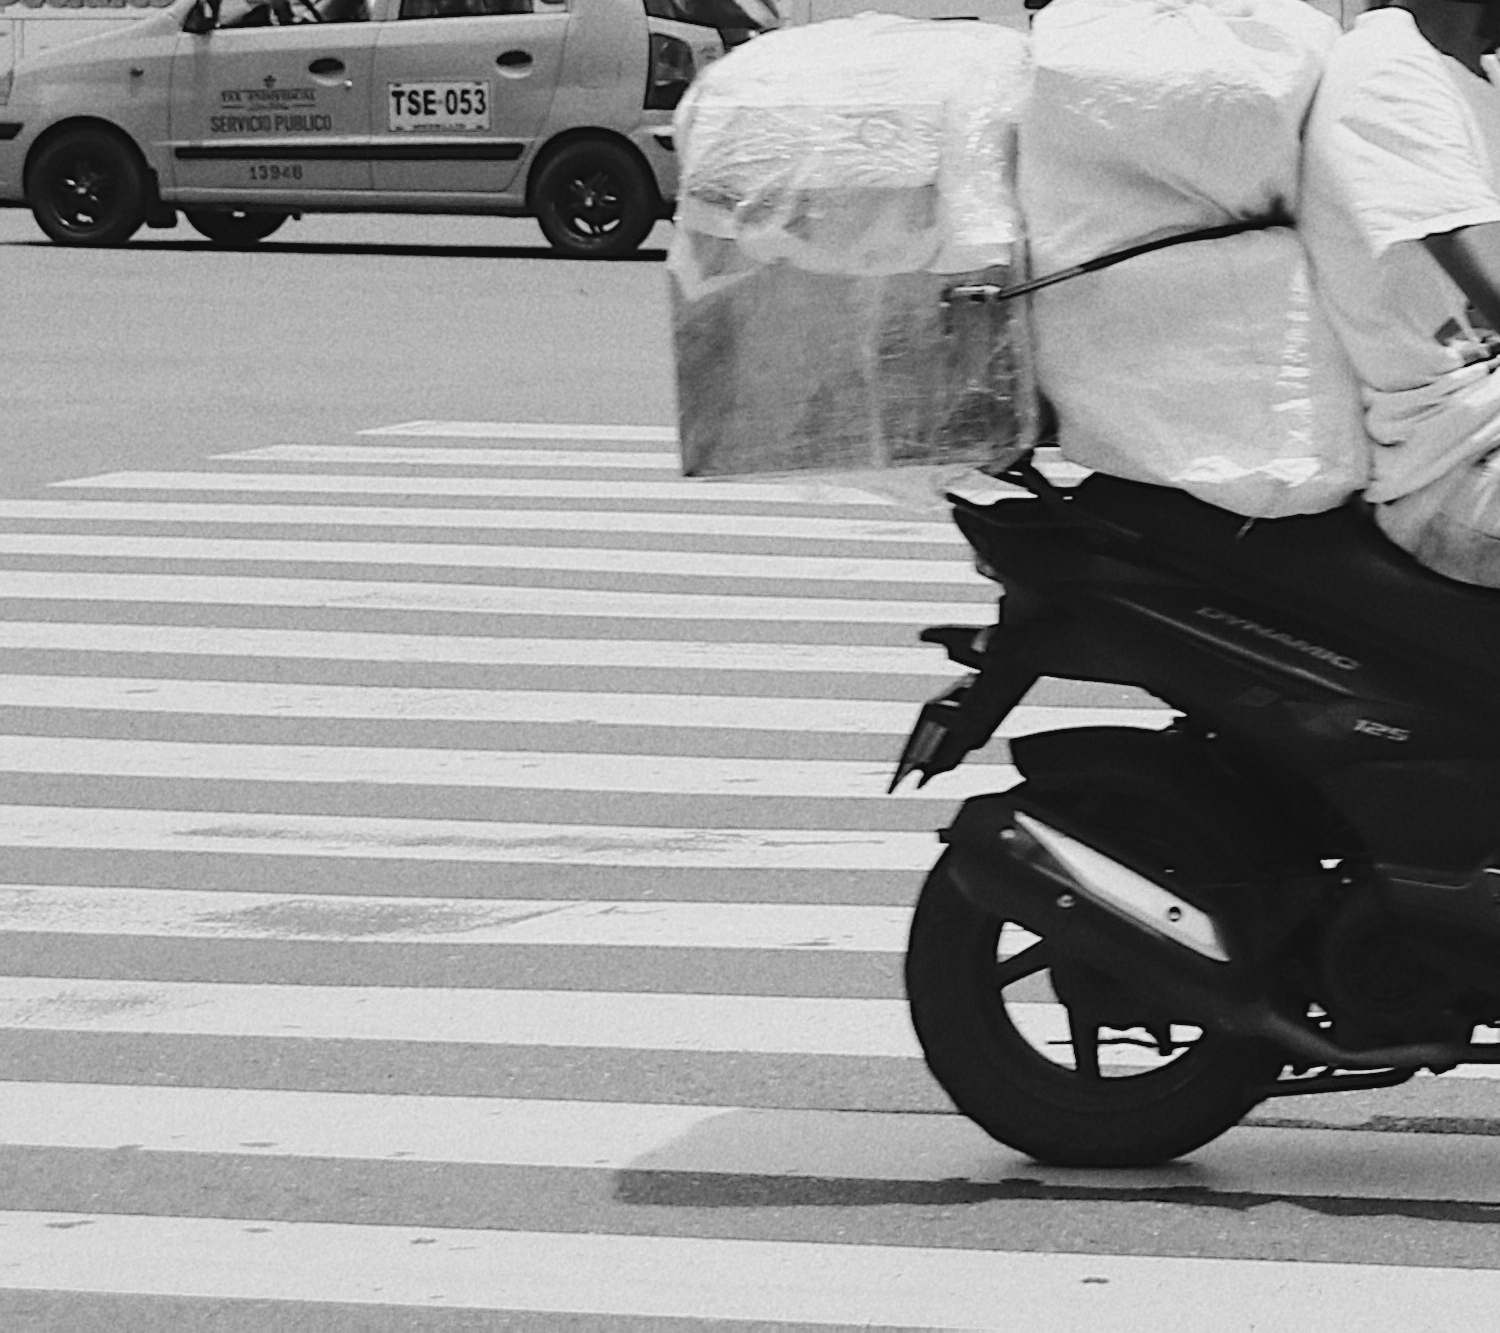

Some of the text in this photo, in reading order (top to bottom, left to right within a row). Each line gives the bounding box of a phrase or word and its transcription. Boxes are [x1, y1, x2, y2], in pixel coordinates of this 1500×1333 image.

[210, 114, 332, 133] SERVICIO PUBLICO
[1196, 606, 1362, 670] DYNAMIC
[1353, 719, 1411, 741] 125
